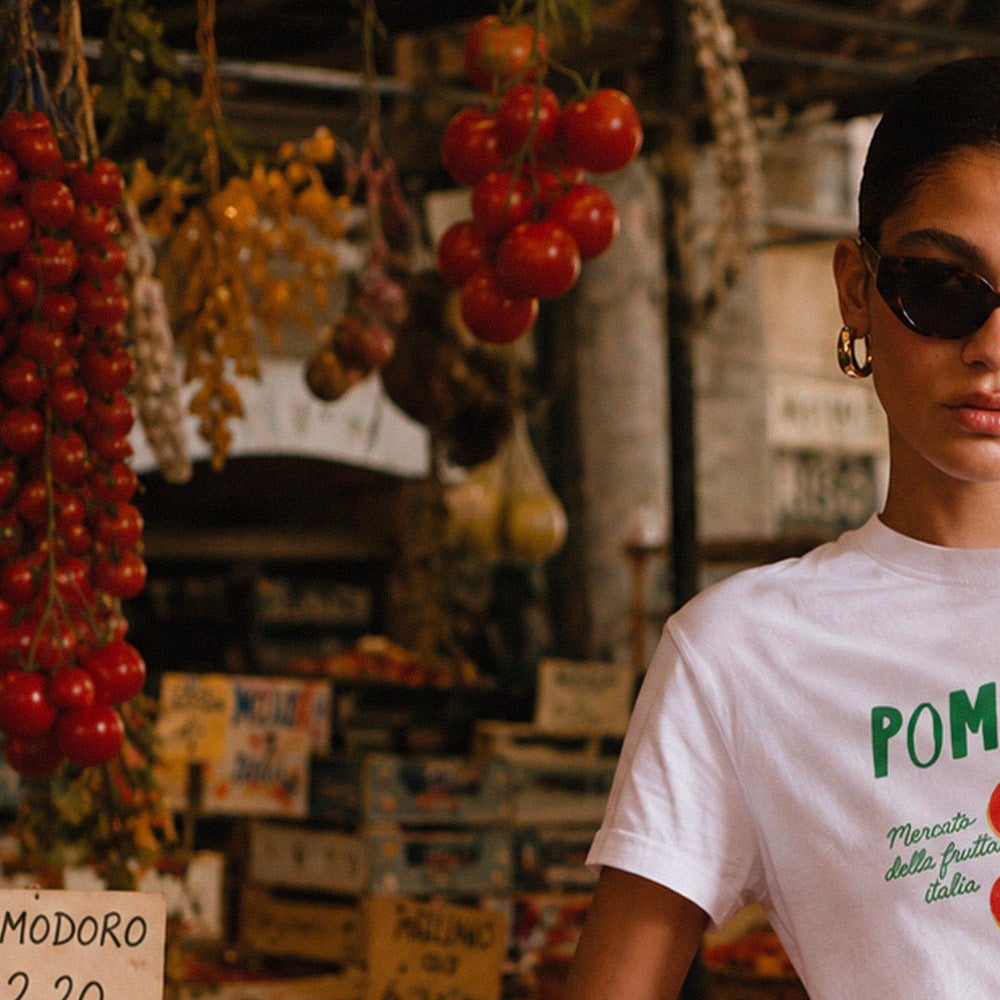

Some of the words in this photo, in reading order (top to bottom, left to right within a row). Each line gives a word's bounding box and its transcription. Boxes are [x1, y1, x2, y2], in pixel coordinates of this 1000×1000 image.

[887, 812, 977, 849] Mercato
[884, 848, 936, 882] della
[924, 871, 981, 904] italia
